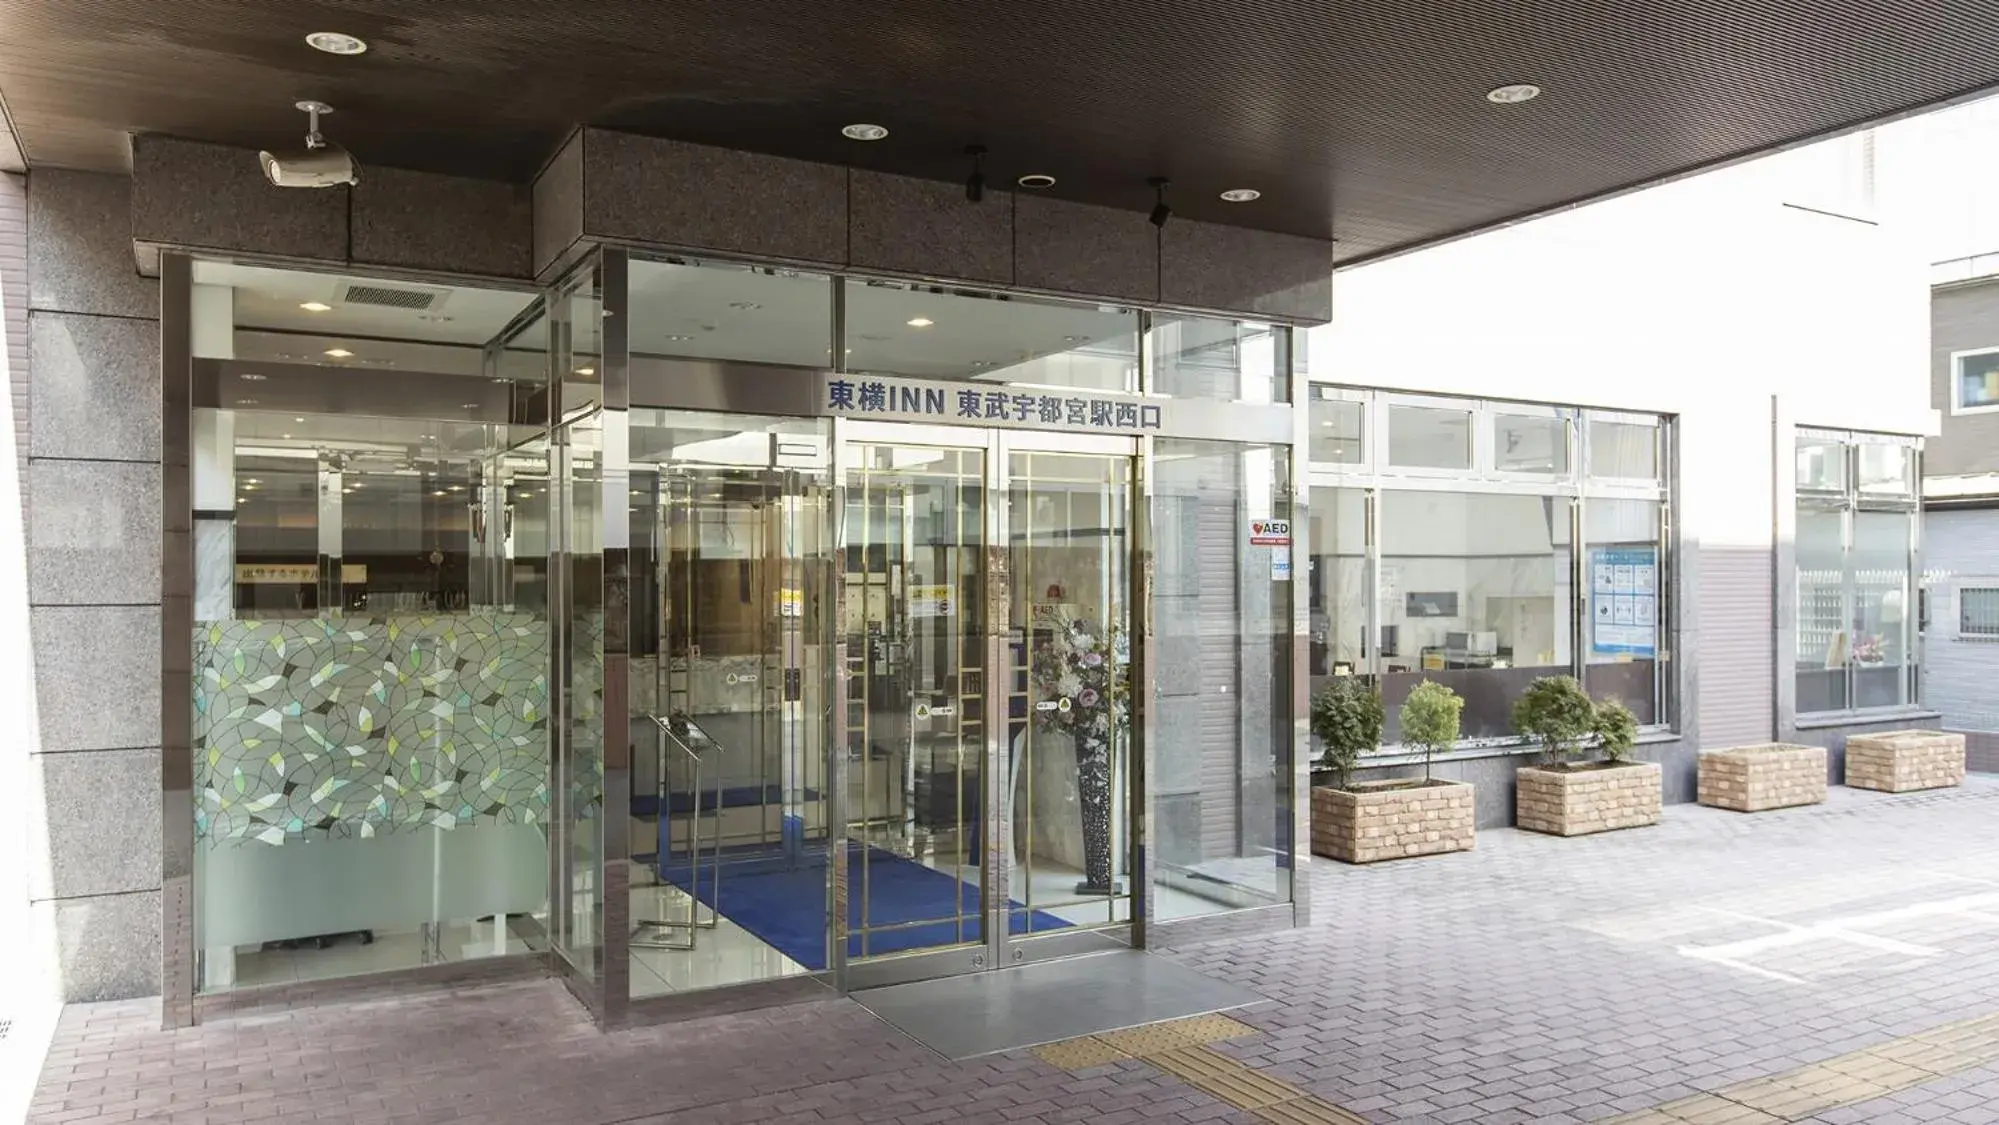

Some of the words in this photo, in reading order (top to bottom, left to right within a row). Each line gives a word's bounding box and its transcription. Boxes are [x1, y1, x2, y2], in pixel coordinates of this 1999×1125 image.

[828, 379, 945, 415] 東横INN
[957, 389, 1162, 429] 東武宇都宮駅西口
[1263, 523, 1289, 534] AED
